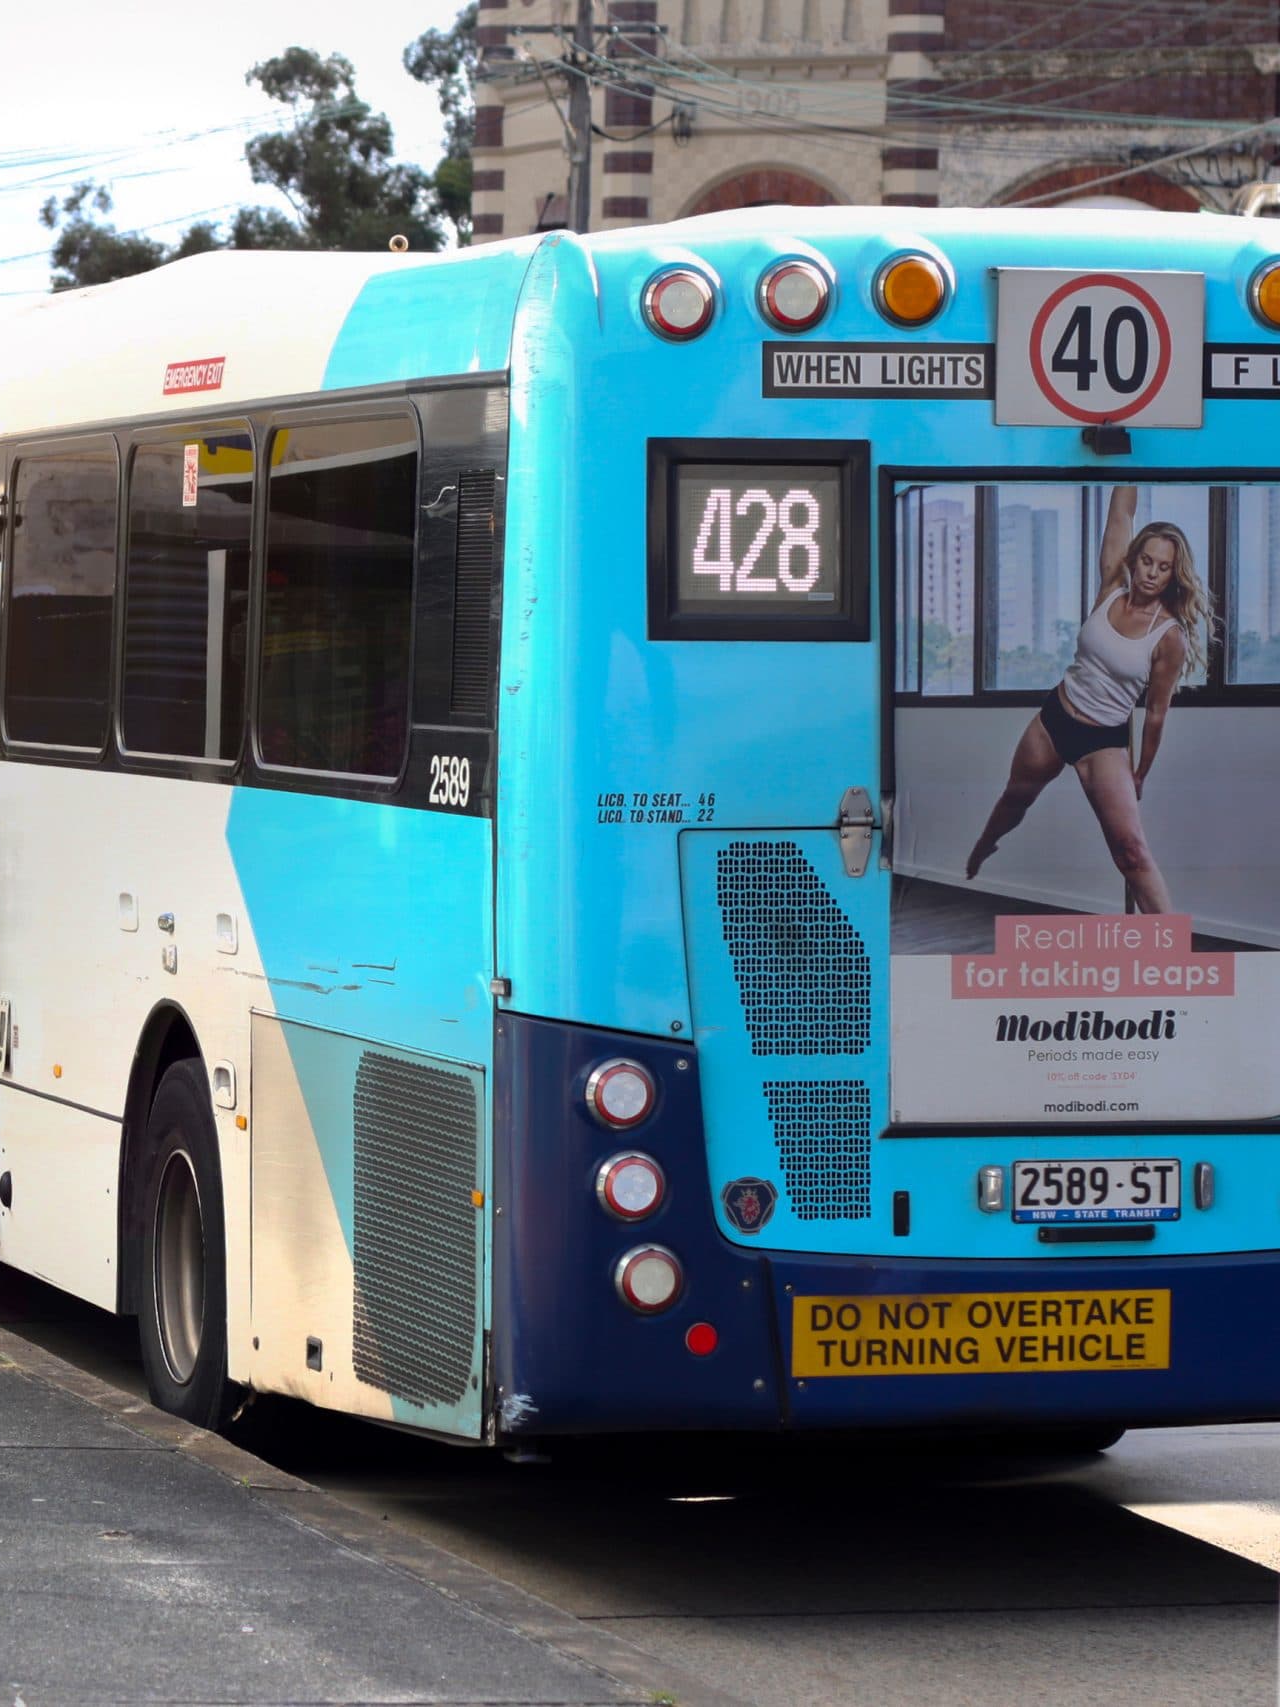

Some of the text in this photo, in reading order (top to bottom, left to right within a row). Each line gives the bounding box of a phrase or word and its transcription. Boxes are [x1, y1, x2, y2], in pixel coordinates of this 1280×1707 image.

[1051, 305, 1149, 394] 40
[165, 362, 224, 389] EMERGENCY EXIT
[776, 355, 983, 386] WHEN LIGHTS
[693, 489, 820, 592] 428
[428, 754, 470, 808] 2589
[632, 793, 648, 807] TO
[630, 810, 644, 823] TO
[697, 808, 715, 822] 22
[1015, 922, 1174, 950] Real life is
[965, 959, 1220, 992] for taking leaps
[995, 1010, 1178, 1042] Modibodi
[1027, 1050, 1160, 1062] Periods made easy
[1082, 1072, 1107, 1081] code
[1044, 1100, 1139, 1113] modibodi.com
[1032, 1211, 1057, 1220] NSW
[1074, 1210, 1108, 1219] STATE
[1113, 1209, 1162, 1219] TRANSIT
[810, 1297, 1155, 1332] DO NOT OVERTAKE
[817, 1333, 1146, 1368] TURNING VEHICLE
